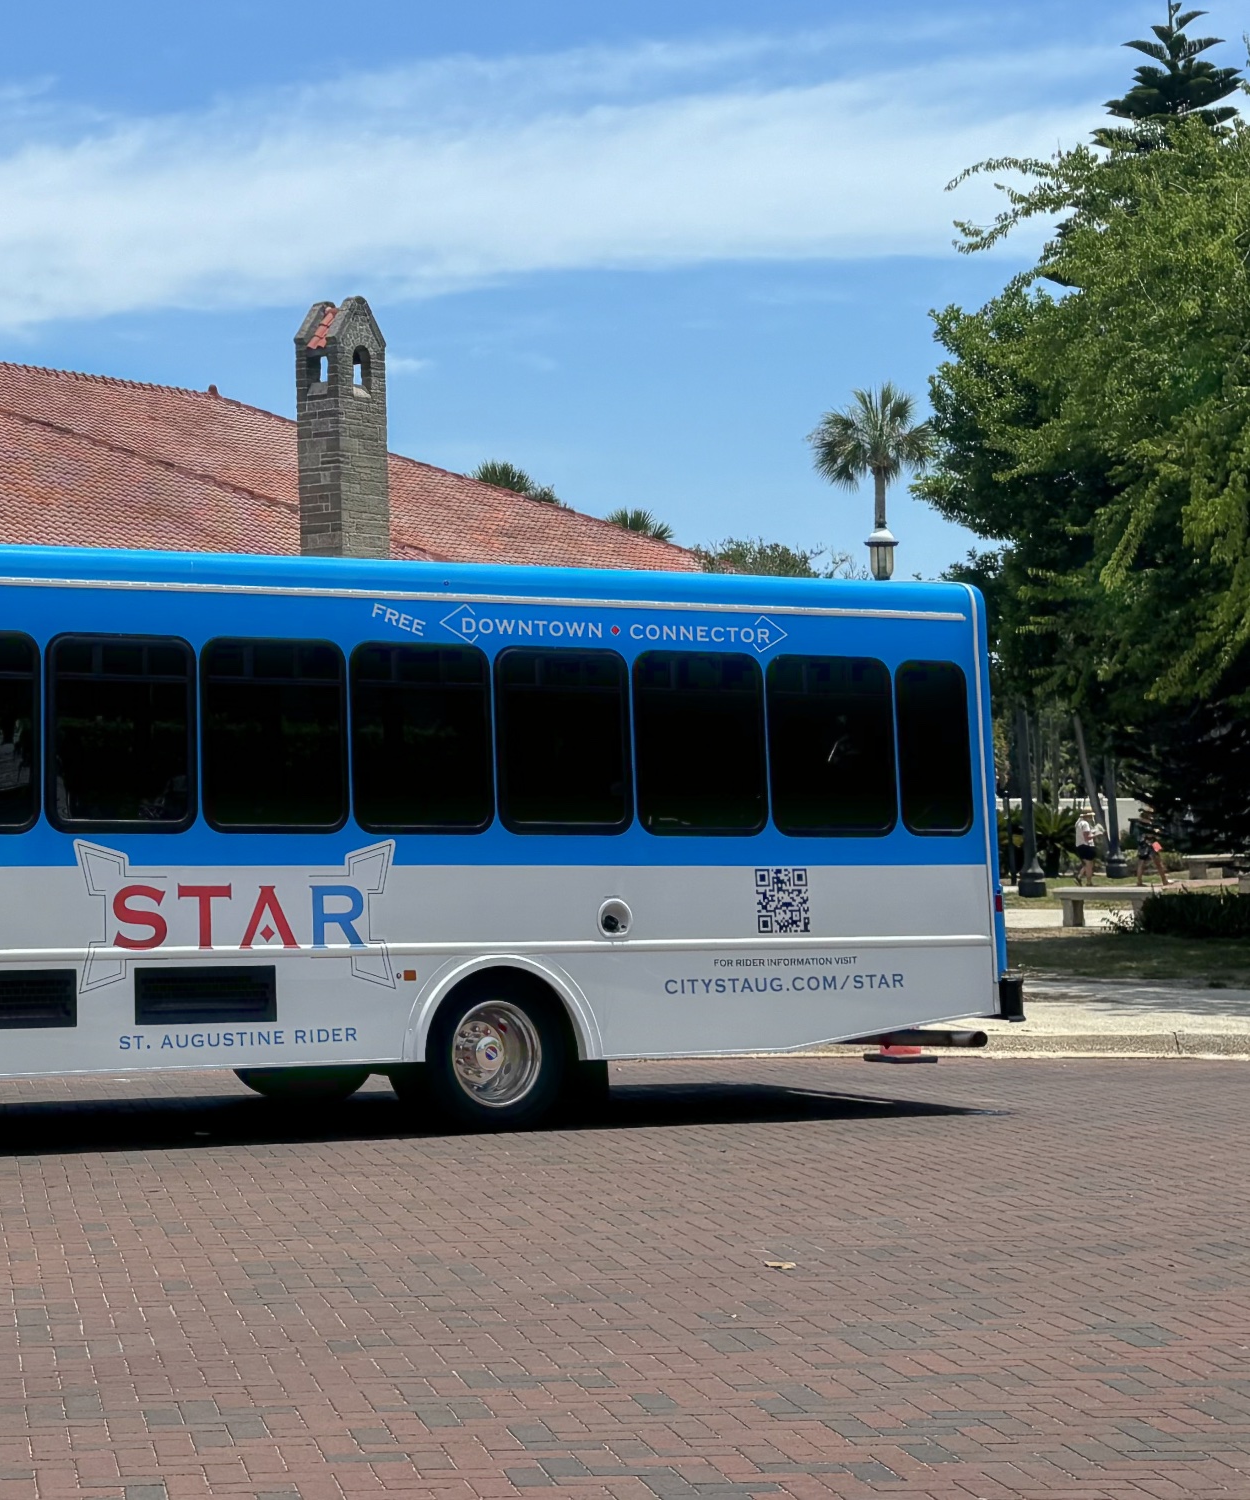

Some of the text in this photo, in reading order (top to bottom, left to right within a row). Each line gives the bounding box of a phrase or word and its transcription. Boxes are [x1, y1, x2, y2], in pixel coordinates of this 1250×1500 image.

[371, 603, 771, 644] FREE DOWNTOWN CONNECTOR
[112, 883, 368, 950] STAR
[713, 956, 857, 967] FOR RIDER INFORMATION VISIT
[664, 973, 904, 994] CITYSTAUG.COM/STAR
[119, 1027, 358, 1051] ST. AUGUSTINE RIDER
